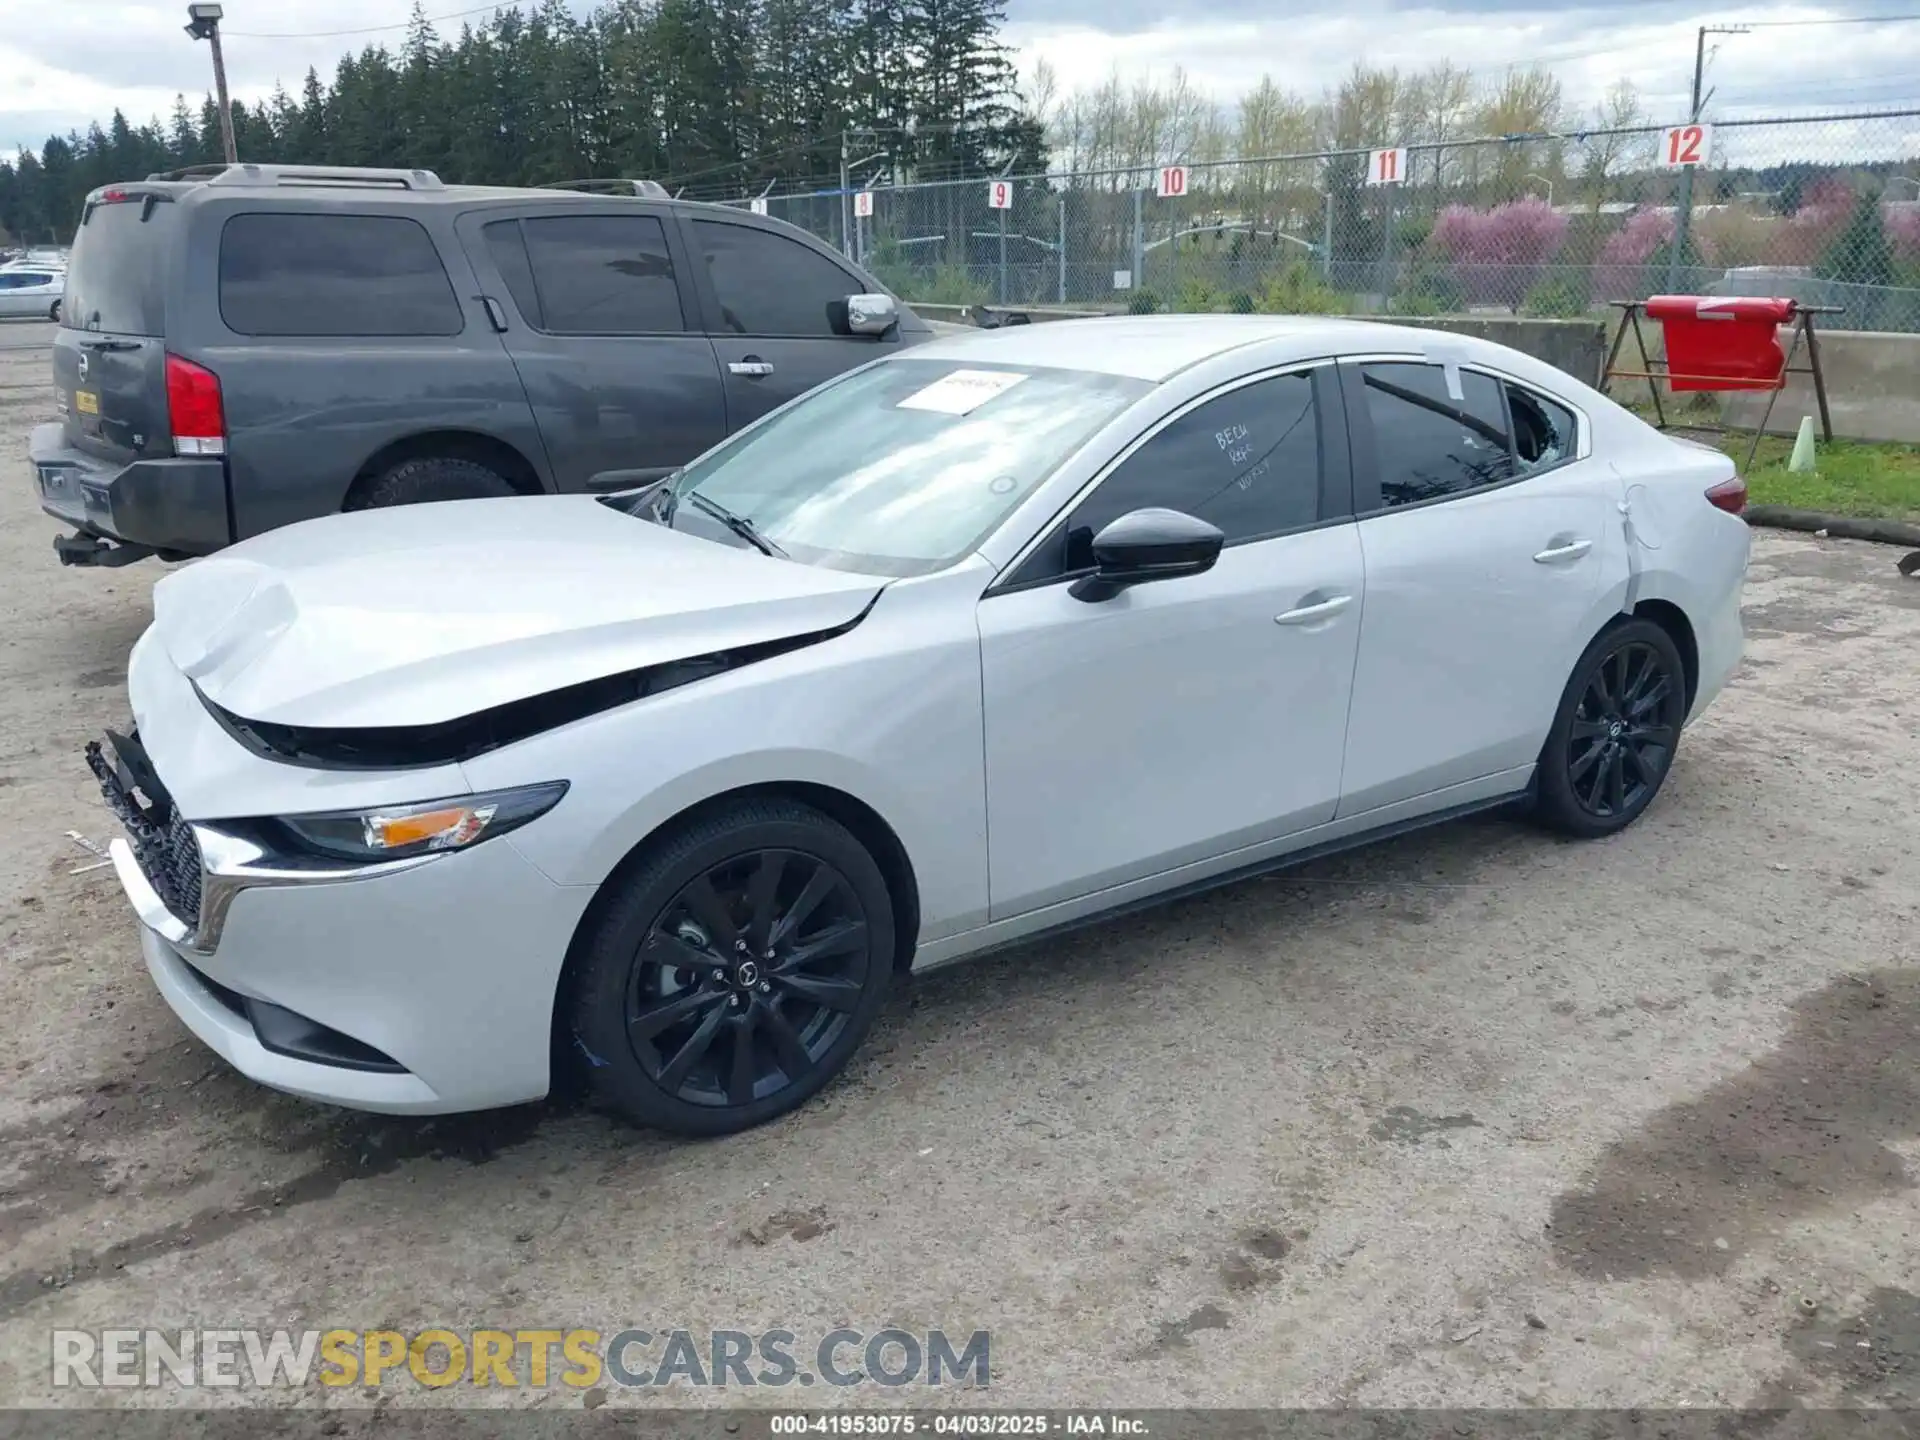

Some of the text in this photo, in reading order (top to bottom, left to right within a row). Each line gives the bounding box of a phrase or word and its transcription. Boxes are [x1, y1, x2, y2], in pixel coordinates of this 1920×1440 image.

[1669, 126, 1703, 163] 12
[1379, 151, 1396, 180] 11
[1163, 168, 1183, 194] 10
[860, 194, 868, 214] 8
[996, 183, 1005, 206] 9
